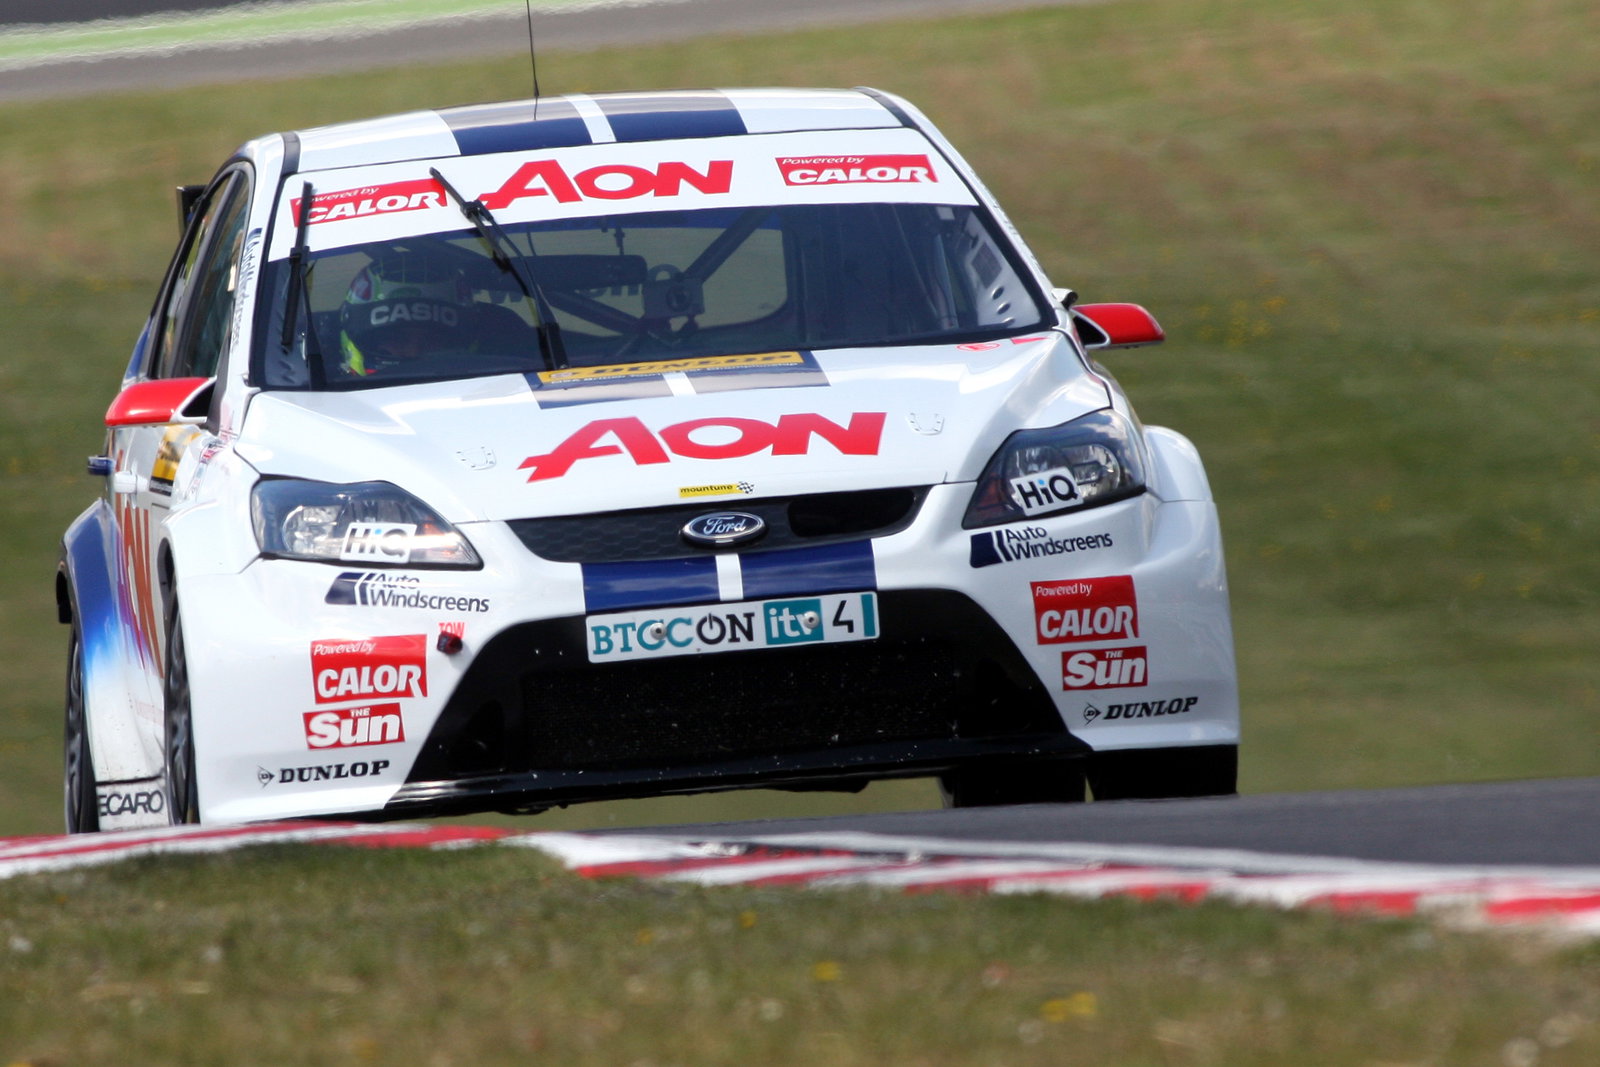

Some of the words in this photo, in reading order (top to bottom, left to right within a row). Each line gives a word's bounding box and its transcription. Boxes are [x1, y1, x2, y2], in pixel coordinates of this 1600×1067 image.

[782, 156, 845, 165] Powered
[847, 156, 864, 165] by
[477, 159, 733, 210] AON
[788, 165, 932, 184] CALOR
[296, 189, 360, 206] wered
[361, 187, 379, 195] by
[307, 191, 443, 222] CALOR
[371, 302, 459, 327] CASIO
[517, 412, 887, 483] AON
[680, 484, 733, 493] mountune
[1017, 474, 1078, 509] HiQ
[703, 516, 746, 535] Ford
[1005, 526, 1047, 544] Auto
[344, 527, 408, 558] HiQ
[1010, 532, 1113, 560] Windscreens
[371, 572, 420, 589] Auto
[1036, 583, 1078, 597] Powered
[1080, 583, 1092, 596] by
[370, 589, 490, 612] Windscreens
[833, 600, 854, 633] 4
[1040, 605, 1138, 639] CALOR
[438, 621, 465, 639] TOW
[313, 642, 363, 656] Powered
[364, 641, 376, 654] by
[1105, 650, 1123, 659] THE
[1063, 652, 1146, 687] Sun
[317, 665, 424, 698] CALOR
[350, 707, 370, 717] THE
[1103, 697, 1198, 720] DUNLOP
[307, 712, 400, 747] Sun
[279, 760, 390, 783] DUNLOP
